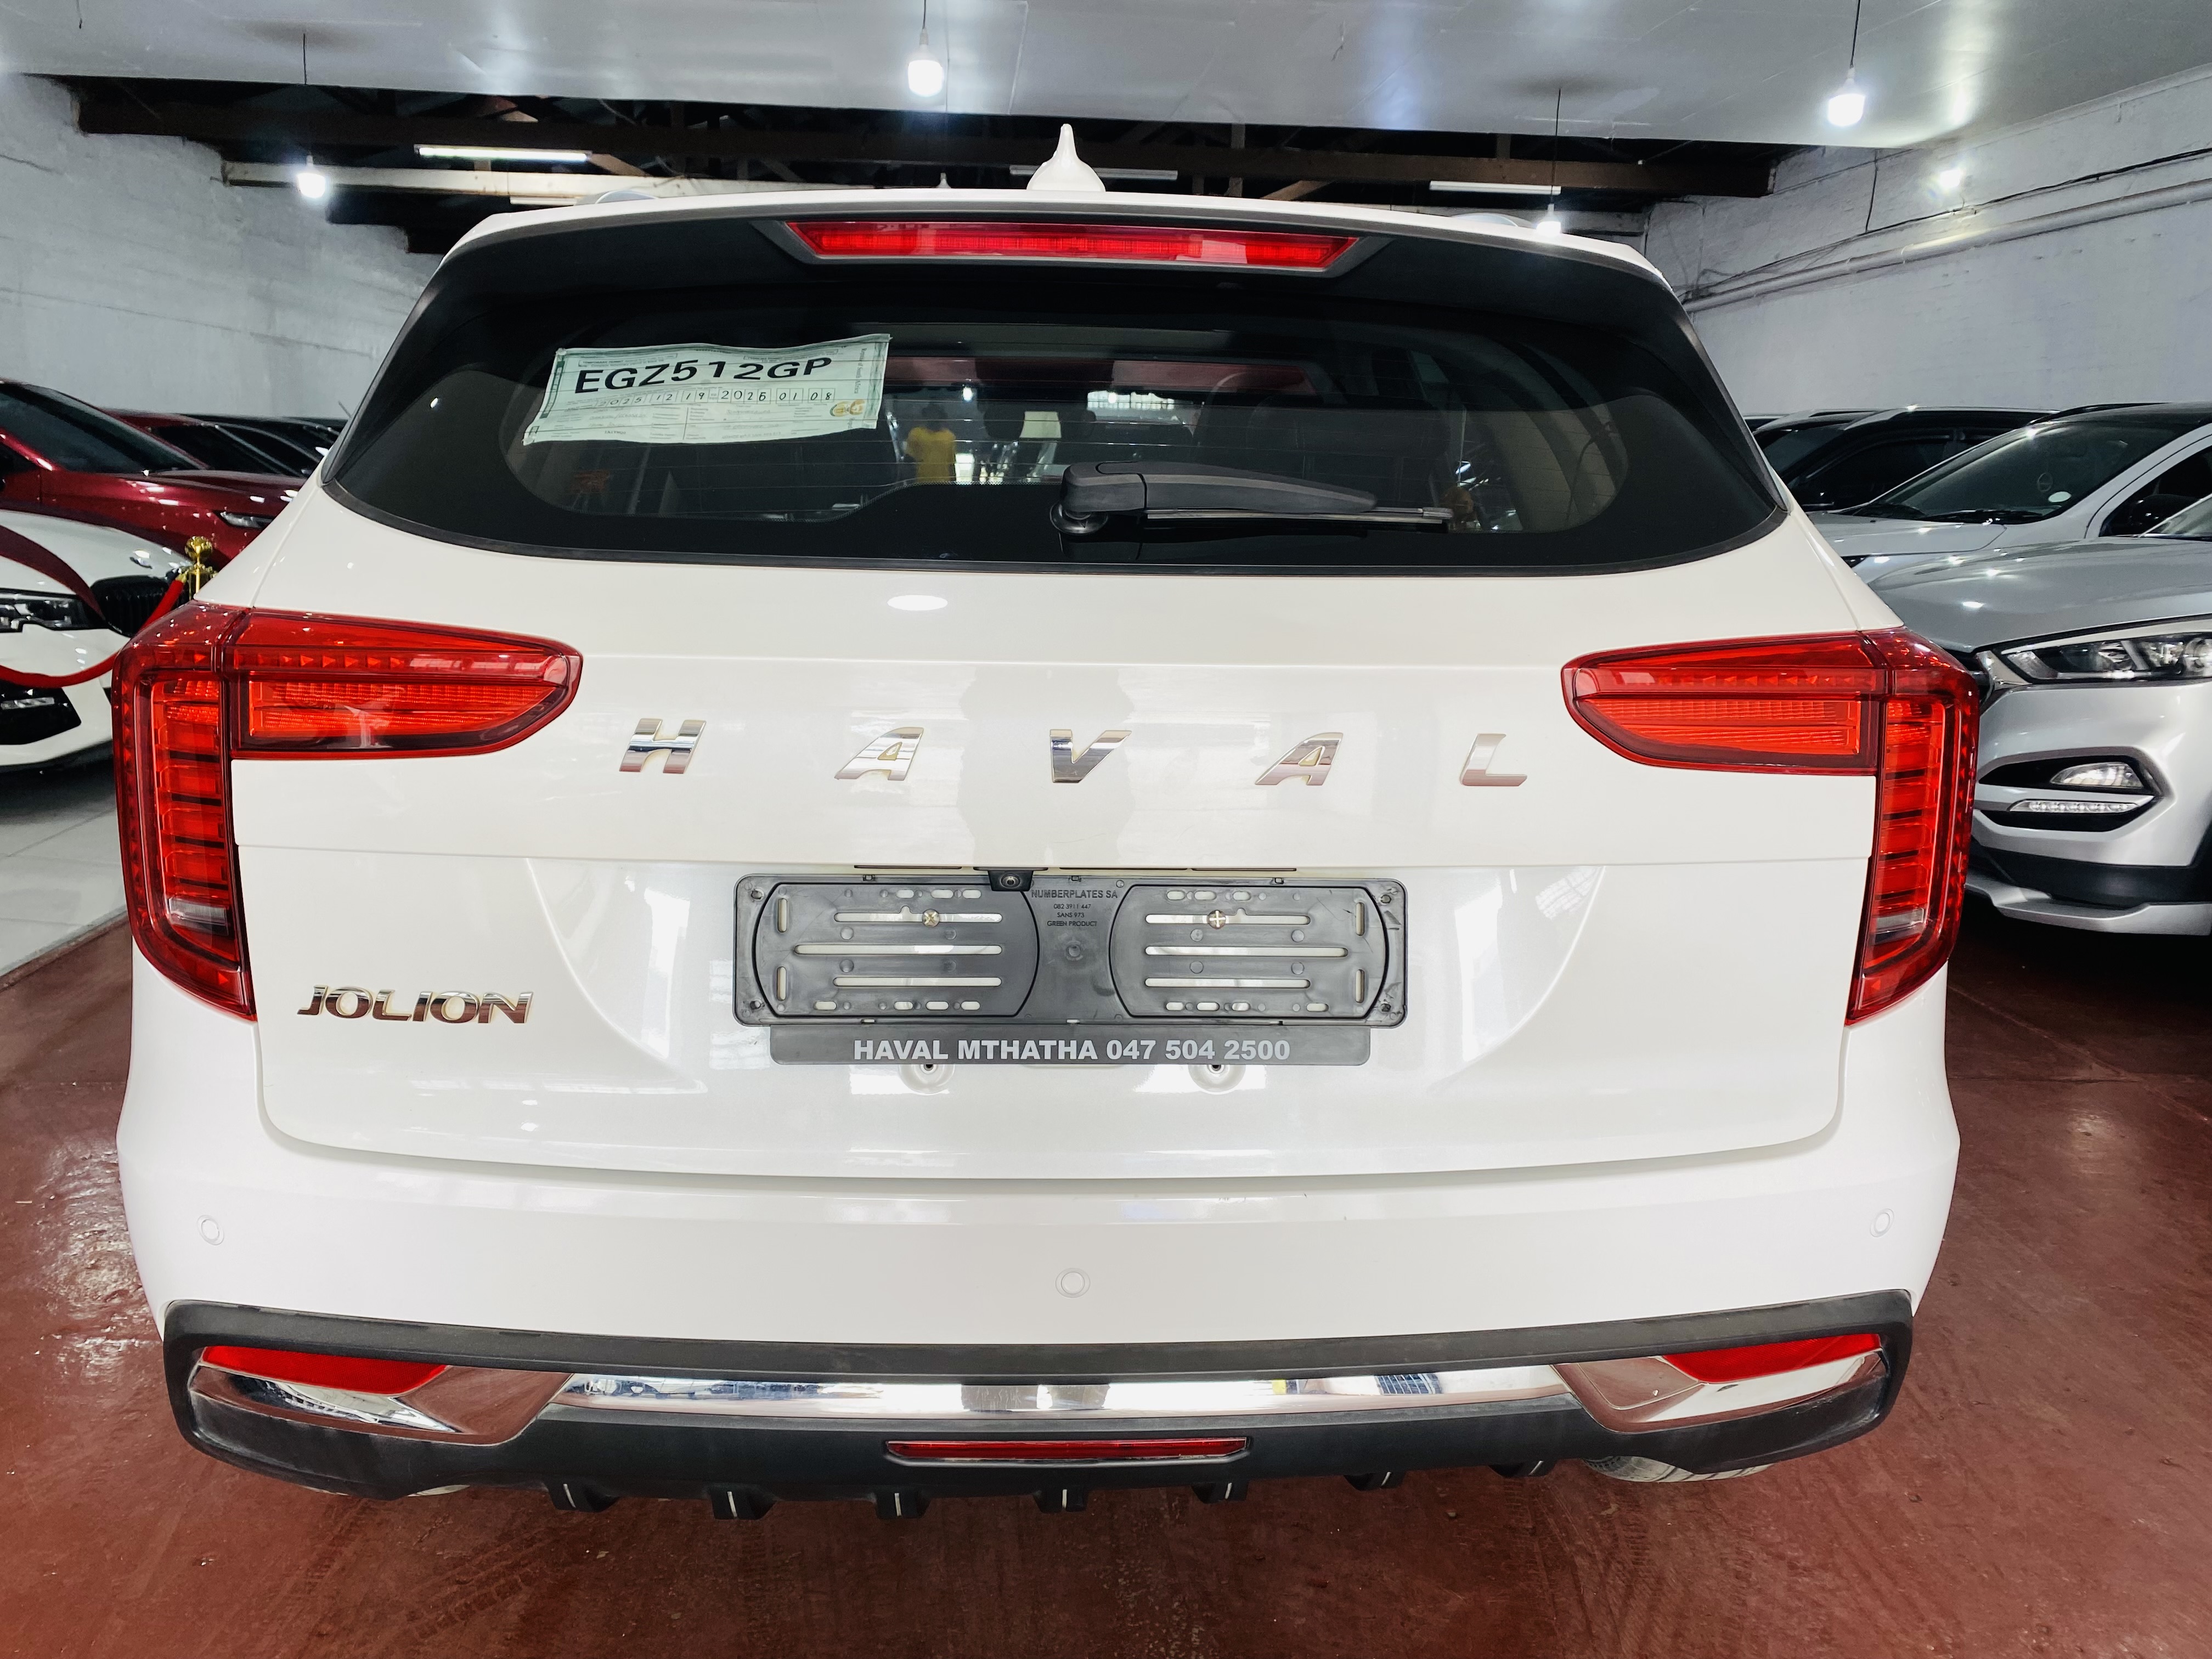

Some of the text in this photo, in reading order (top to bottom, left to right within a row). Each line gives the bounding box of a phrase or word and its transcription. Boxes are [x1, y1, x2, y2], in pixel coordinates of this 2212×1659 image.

[574, 357, 832, 394] EGZ512GP
[686, 392, 705, 400] 19
[779, 392, 797, 400] 01
[810, 392, 832, 400] 08
[618, 718, 1528, 787] HAVAL
[1031, 889, 1118, 899] NUMBERPLATES SA
[296, 985, 534, 1024] JOLION
[854, 1039, 1291, 1060] HAVAL MTHATHA 047 504 2500
